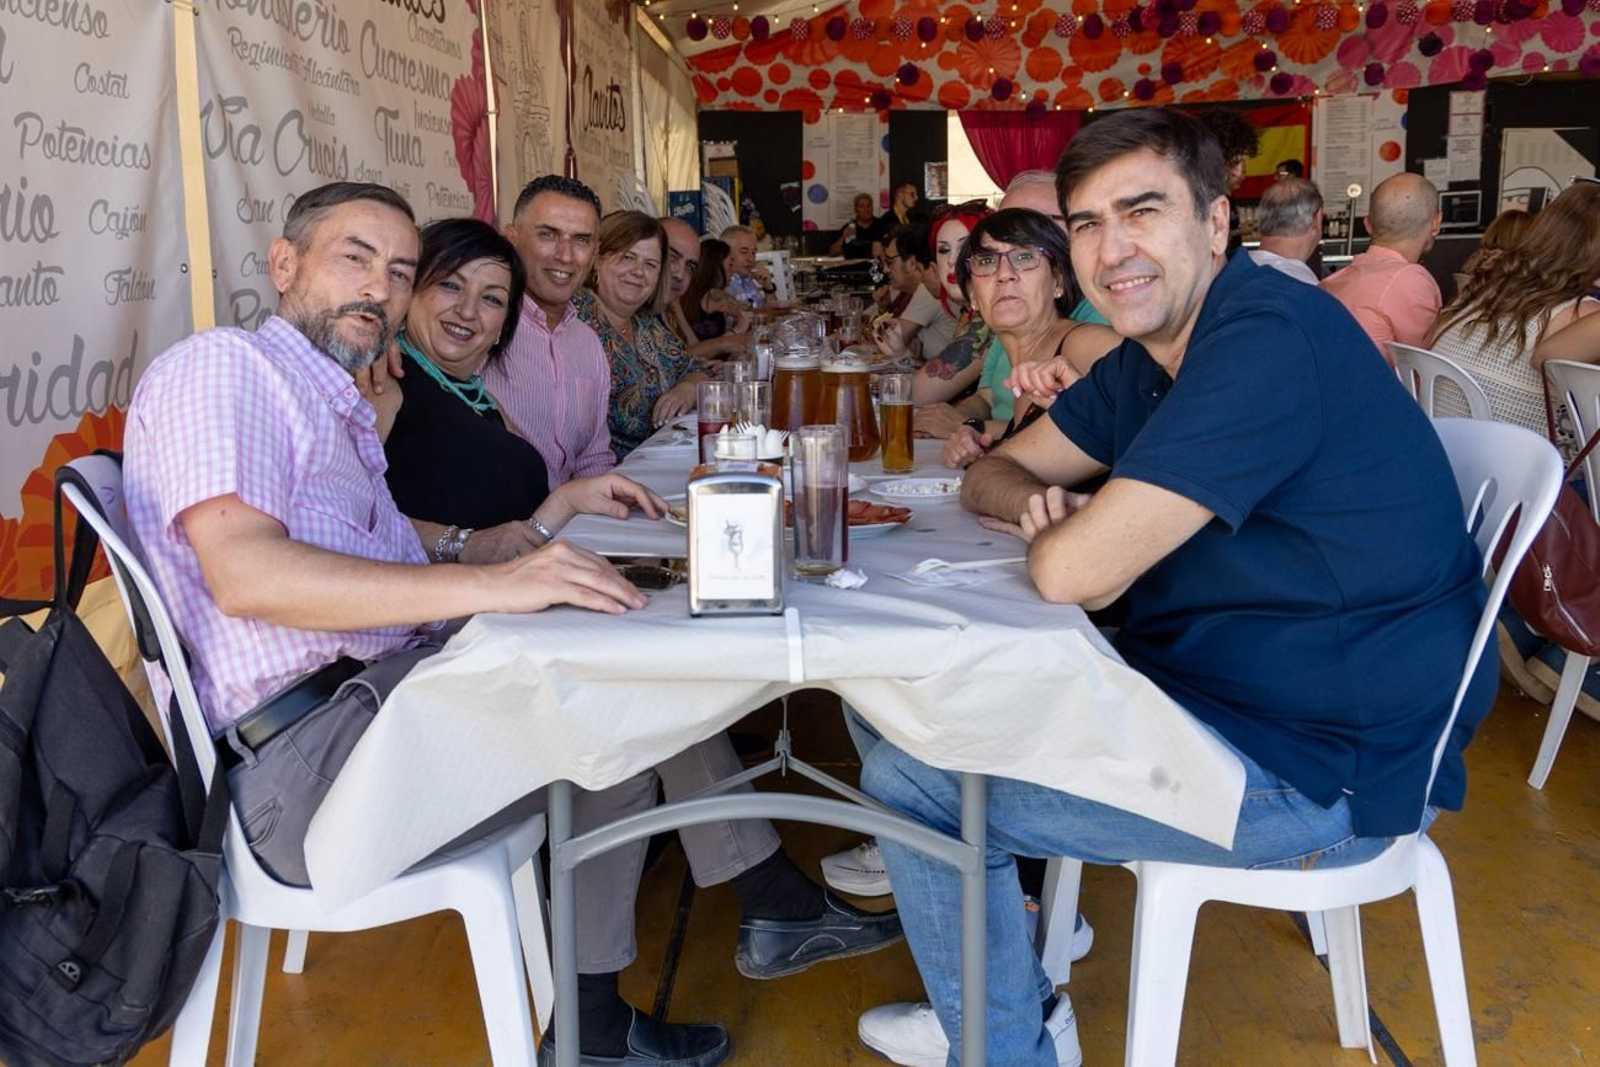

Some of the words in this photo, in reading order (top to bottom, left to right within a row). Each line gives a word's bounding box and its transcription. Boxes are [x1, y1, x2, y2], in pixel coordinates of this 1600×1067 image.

[74, 62, 130, 99] Costal
[360, 19, 450, 101] Cuaresma
[14, 111, 151, 170] Potencias
[274, 109, 348, 181] Crucis
[374, 106, 424, 168] Tuna
[89, 199, 146, 239] Cajón
[104, 266, 157, 306] Faldón
